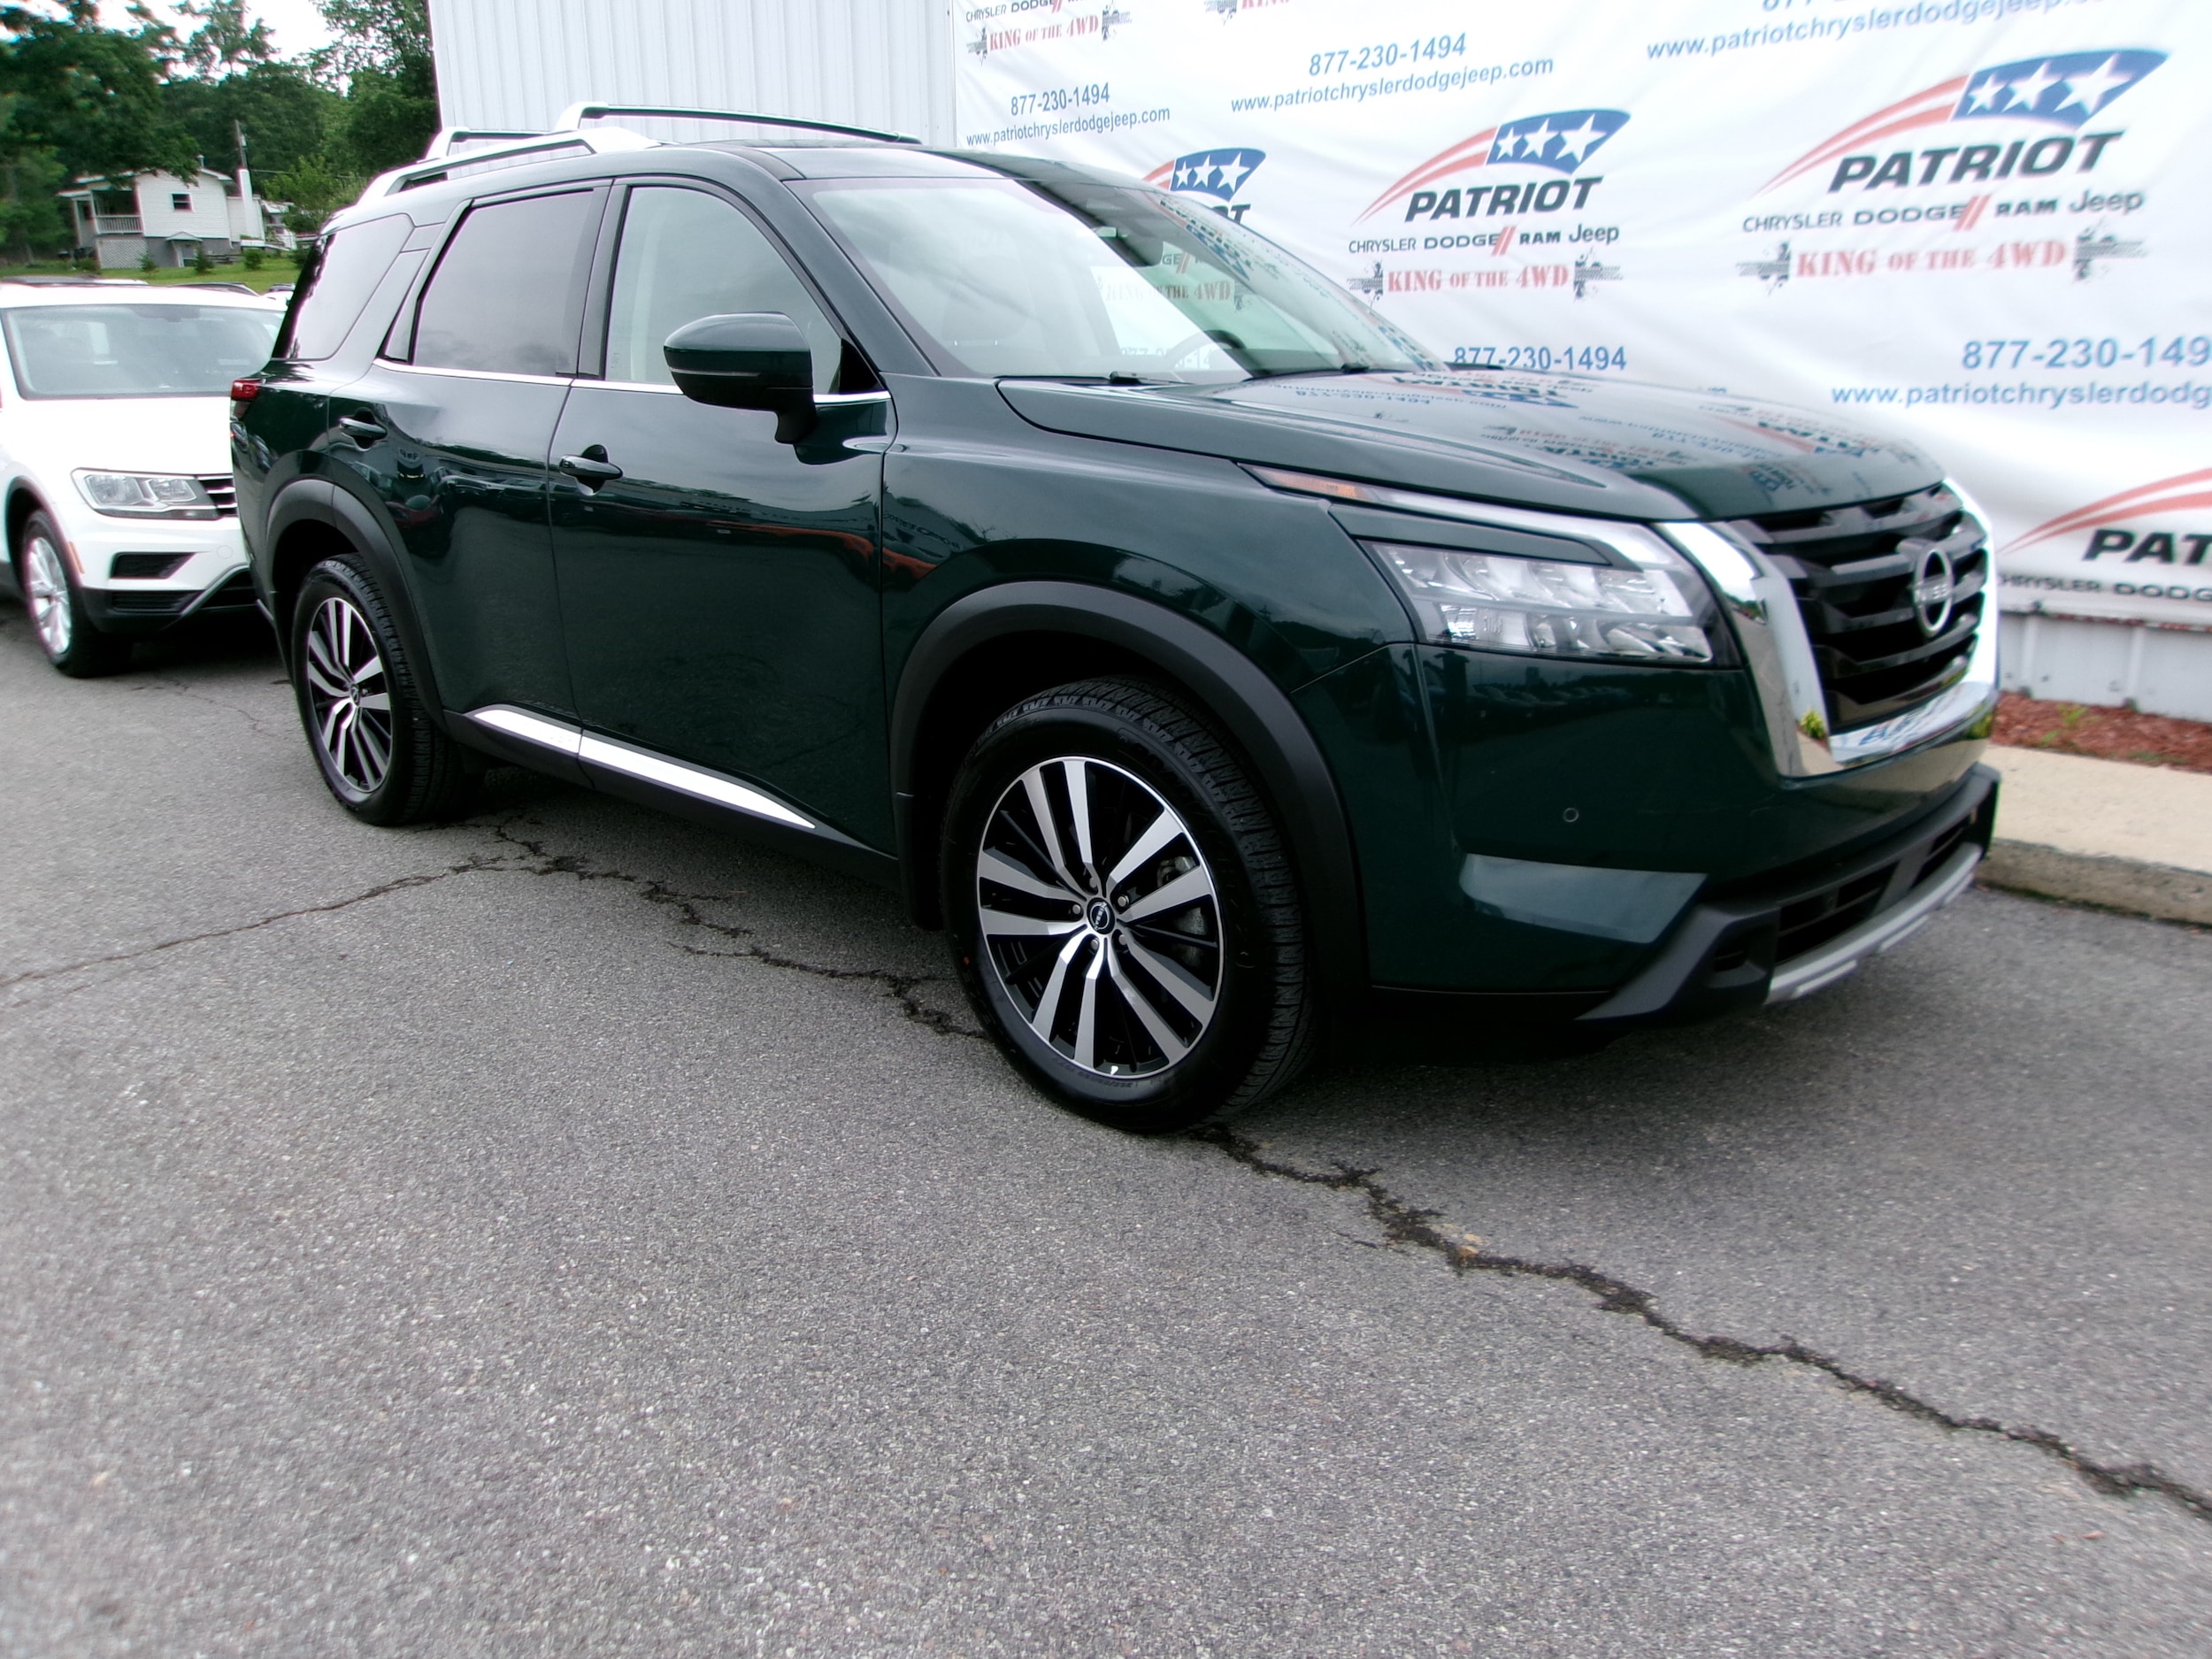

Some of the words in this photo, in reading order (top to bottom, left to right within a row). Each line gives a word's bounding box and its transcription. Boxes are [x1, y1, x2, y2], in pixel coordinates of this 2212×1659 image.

[965, 4, 1007, 22] CHRYSLER
[1647, 0, 2108, 59] www.patriotchryslerdodgejeep.
[989, 27, 1021, 51] KING
[1025, 28, 1039, 42] OF
[1041, 24, 1062, 40] THE
[1067, 15, 1099, 37] 4WD
[1309, 32, 1467, 77] 877-230-1494
[1010, 81, 1110, 116] 877-230-1494
[1231, 57, 1554, 112] www.patriotchryslerdodgejeep.com
[966, 107, 1171, 146] www.patriotchryslerdodgejeep.com
[1828, 129, 2125, 194] PATRIOT
[1404, 175, 1604, 223] PATRIOT
[1742, 211, 1843, 233] CHRYSLER
[1854, 204, 1969, 226] DODGE
[1994, 199, 2058, 219] RAM
[2069, 189, 2145, 213] Jeep
[1348, 237, 1416, 254] CHRYSLER
[1424, 233, 1501, 250] DODGE
[1519, 231, 1561, 245] RAM
[1569, 223, 1620, 245] Jeep
[1796, 249, 1877, 278] KING
[1887, 252, 1916, 272] OF
[1924, 249, 1975, 270] THE
[1987, 240, 2067, 268] 4WD
[1194, 280, 1231, 301] 4WD
[1387, 270, 1442, 293] KING
[1450, 273, 1470, 288] OF
[1473, 271, 1508, 287] THE
[1516, 265, 1570, 288] 4WD
[1454, 345, 1626, 371] 877-230-1494
